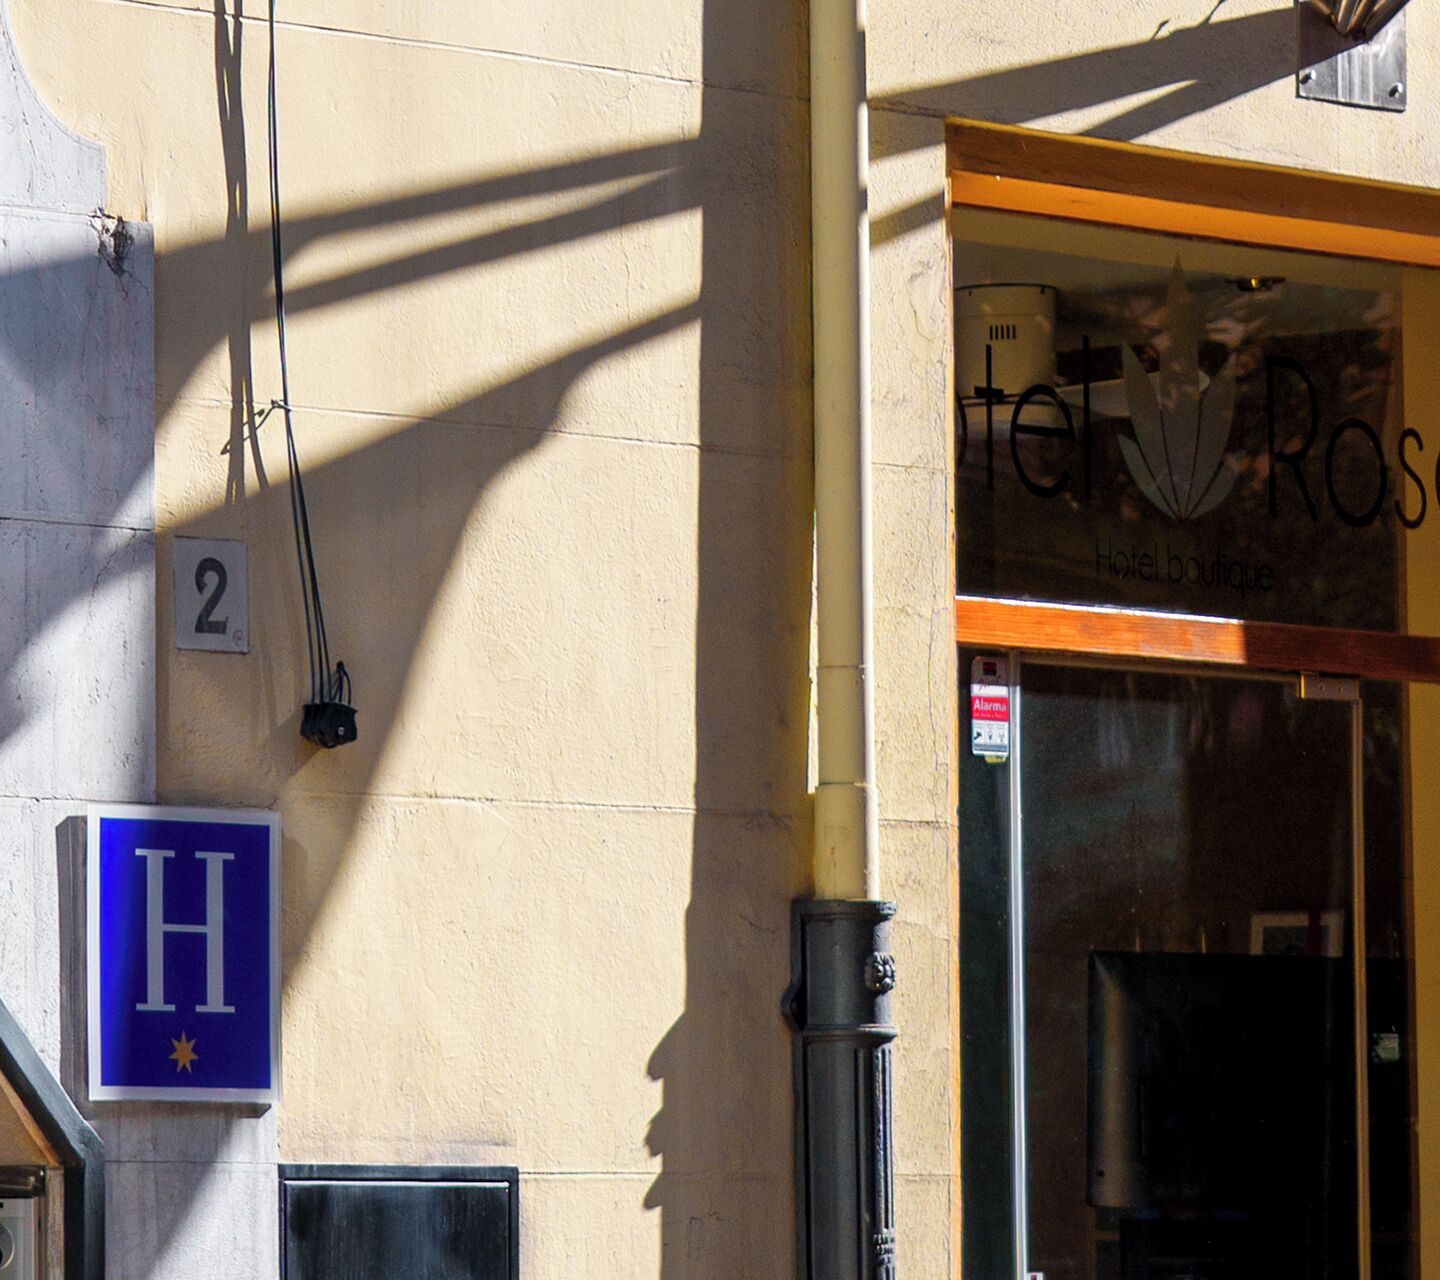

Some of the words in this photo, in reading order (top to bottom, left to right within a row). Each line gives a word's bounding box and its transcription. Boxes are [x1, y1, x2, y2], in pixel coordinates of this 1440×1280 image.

[956, 334, 1091, 500] tel
[1266, 355, 1440, 530] Ros
[194, 556, 229, 635] 2
[1095, 538, 1158, 581] Hotel
[1167, 543, 1276, 599] boutique
[973, 698, 1007, 712] Alarma
[135, 847, 235, 1014] H
